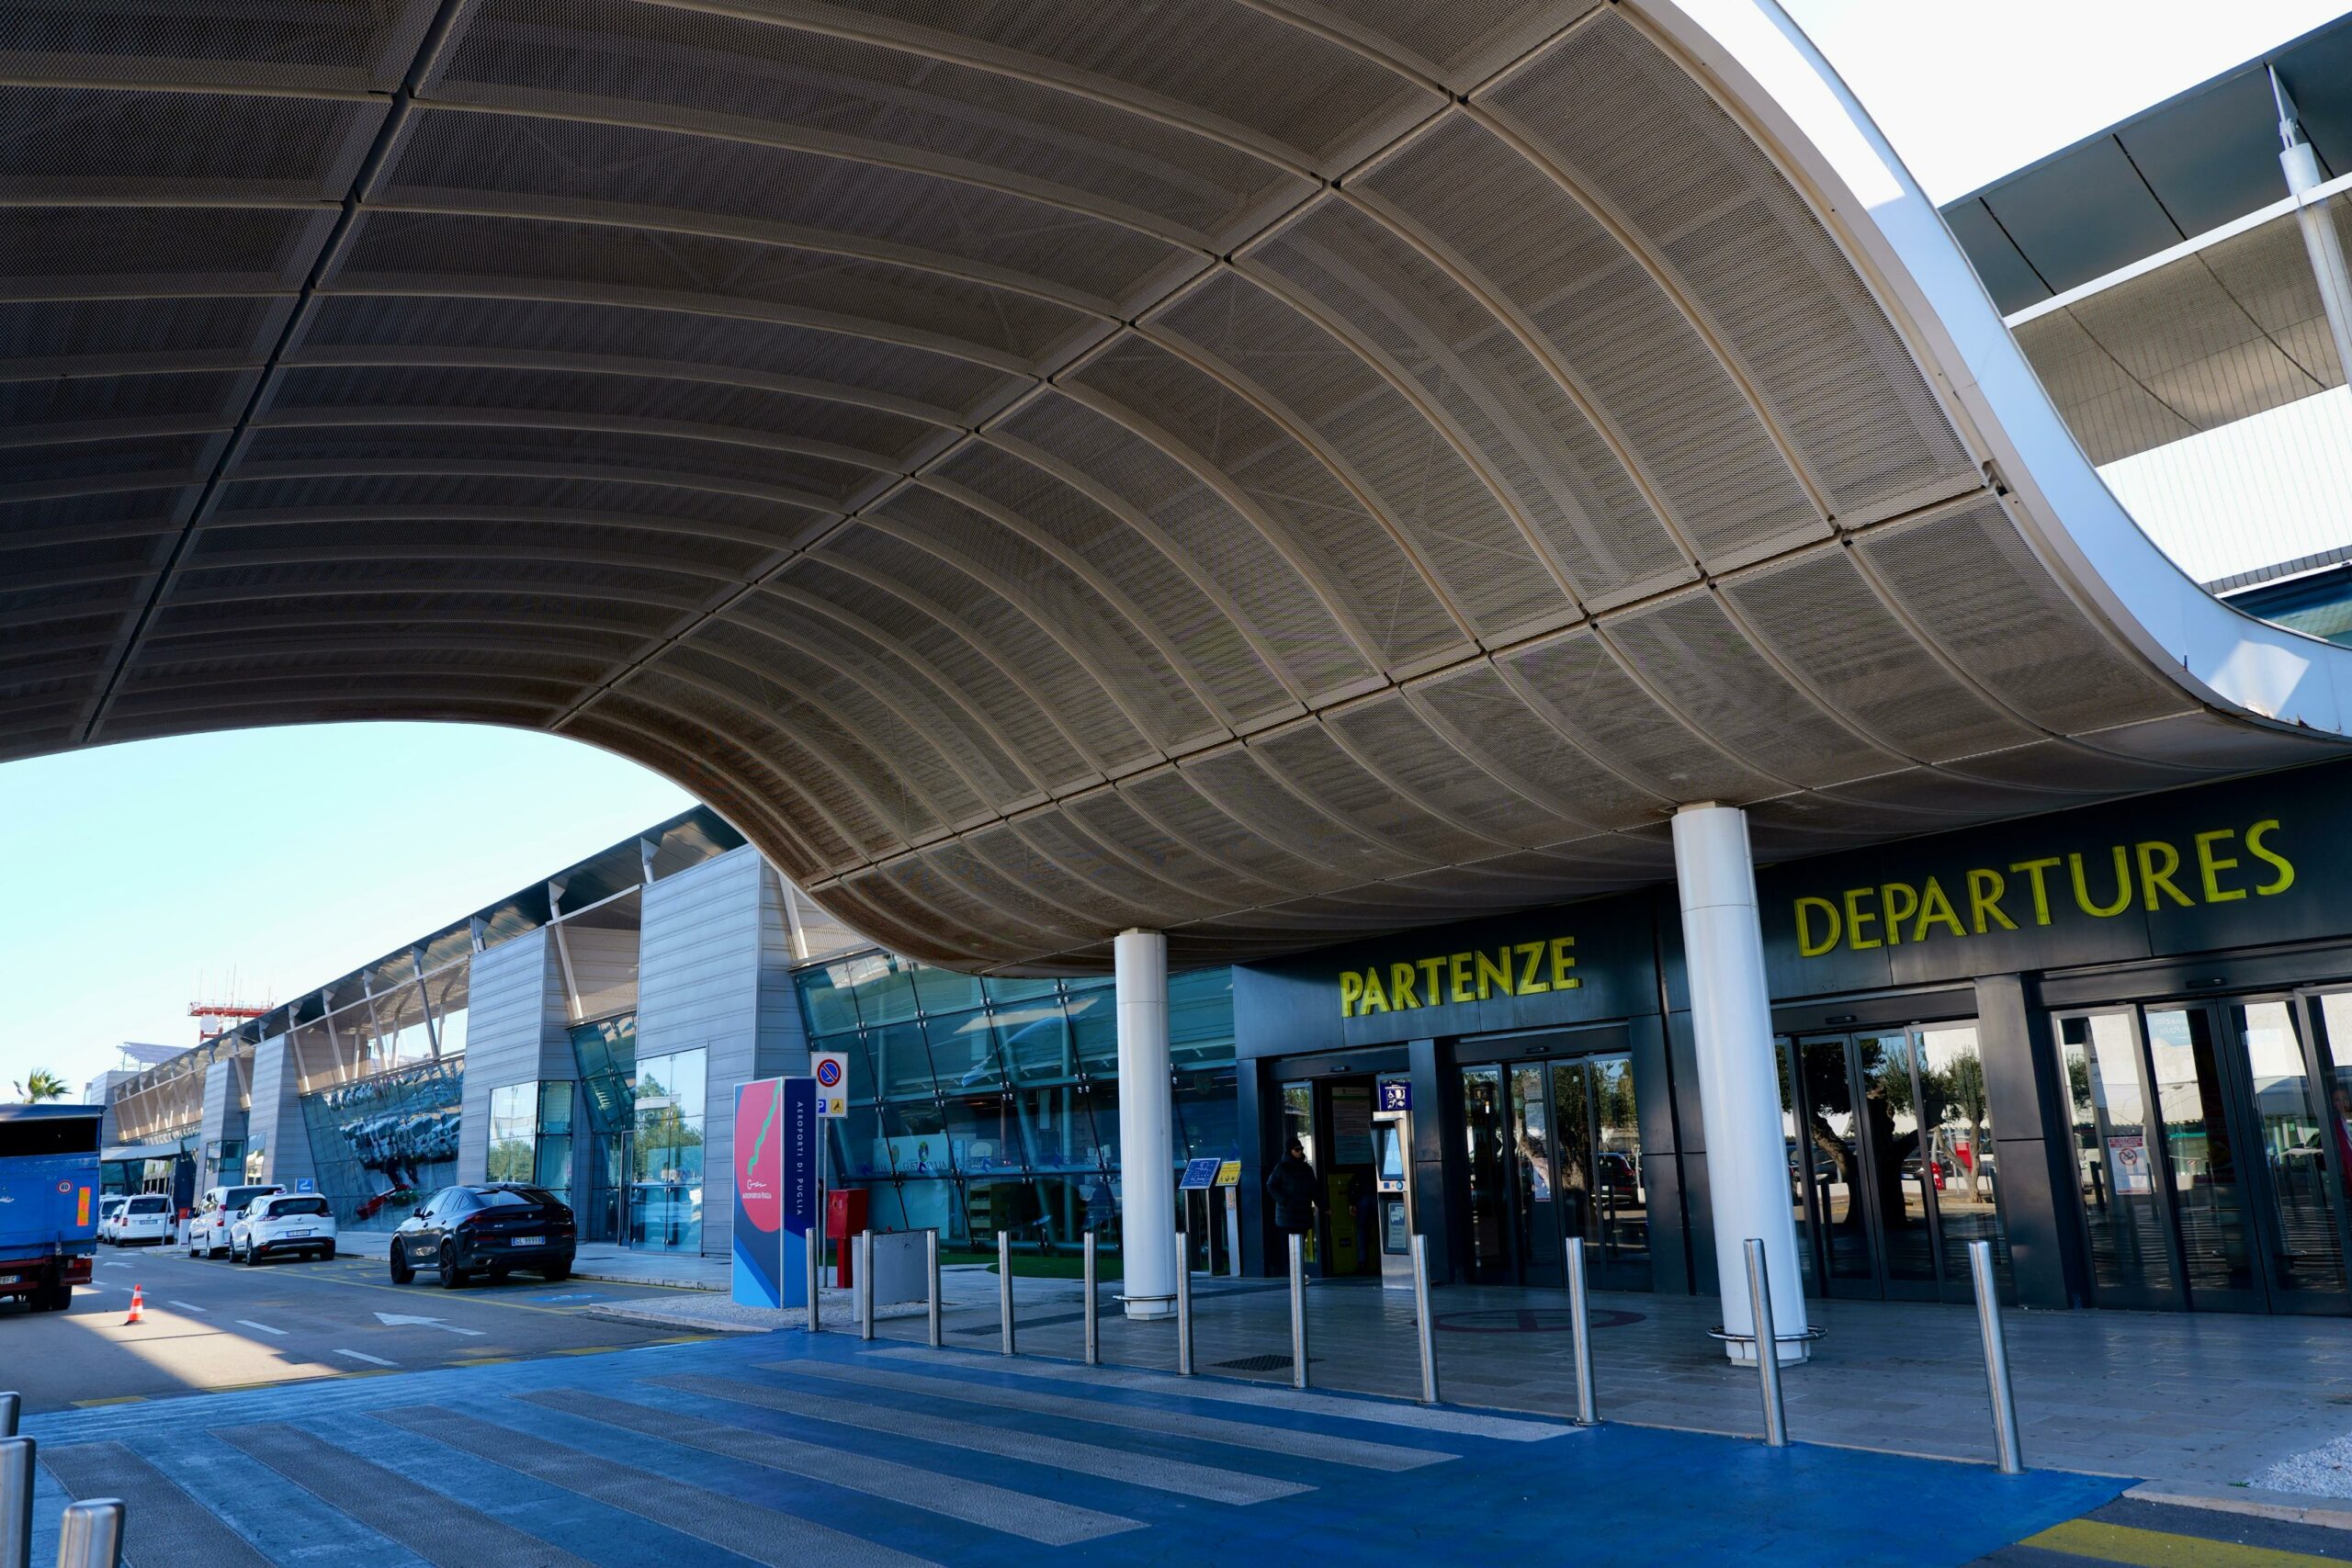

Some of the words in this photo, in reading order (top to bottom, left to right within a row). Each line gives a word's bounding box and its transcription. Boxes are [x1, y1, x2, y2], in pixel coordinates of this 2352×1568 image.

[1793, 819, 2295, 958] DEPARTURES
[1340, 936, 1582, 1019] PARTENZE
[797, 1162, 804, 1172] DI
